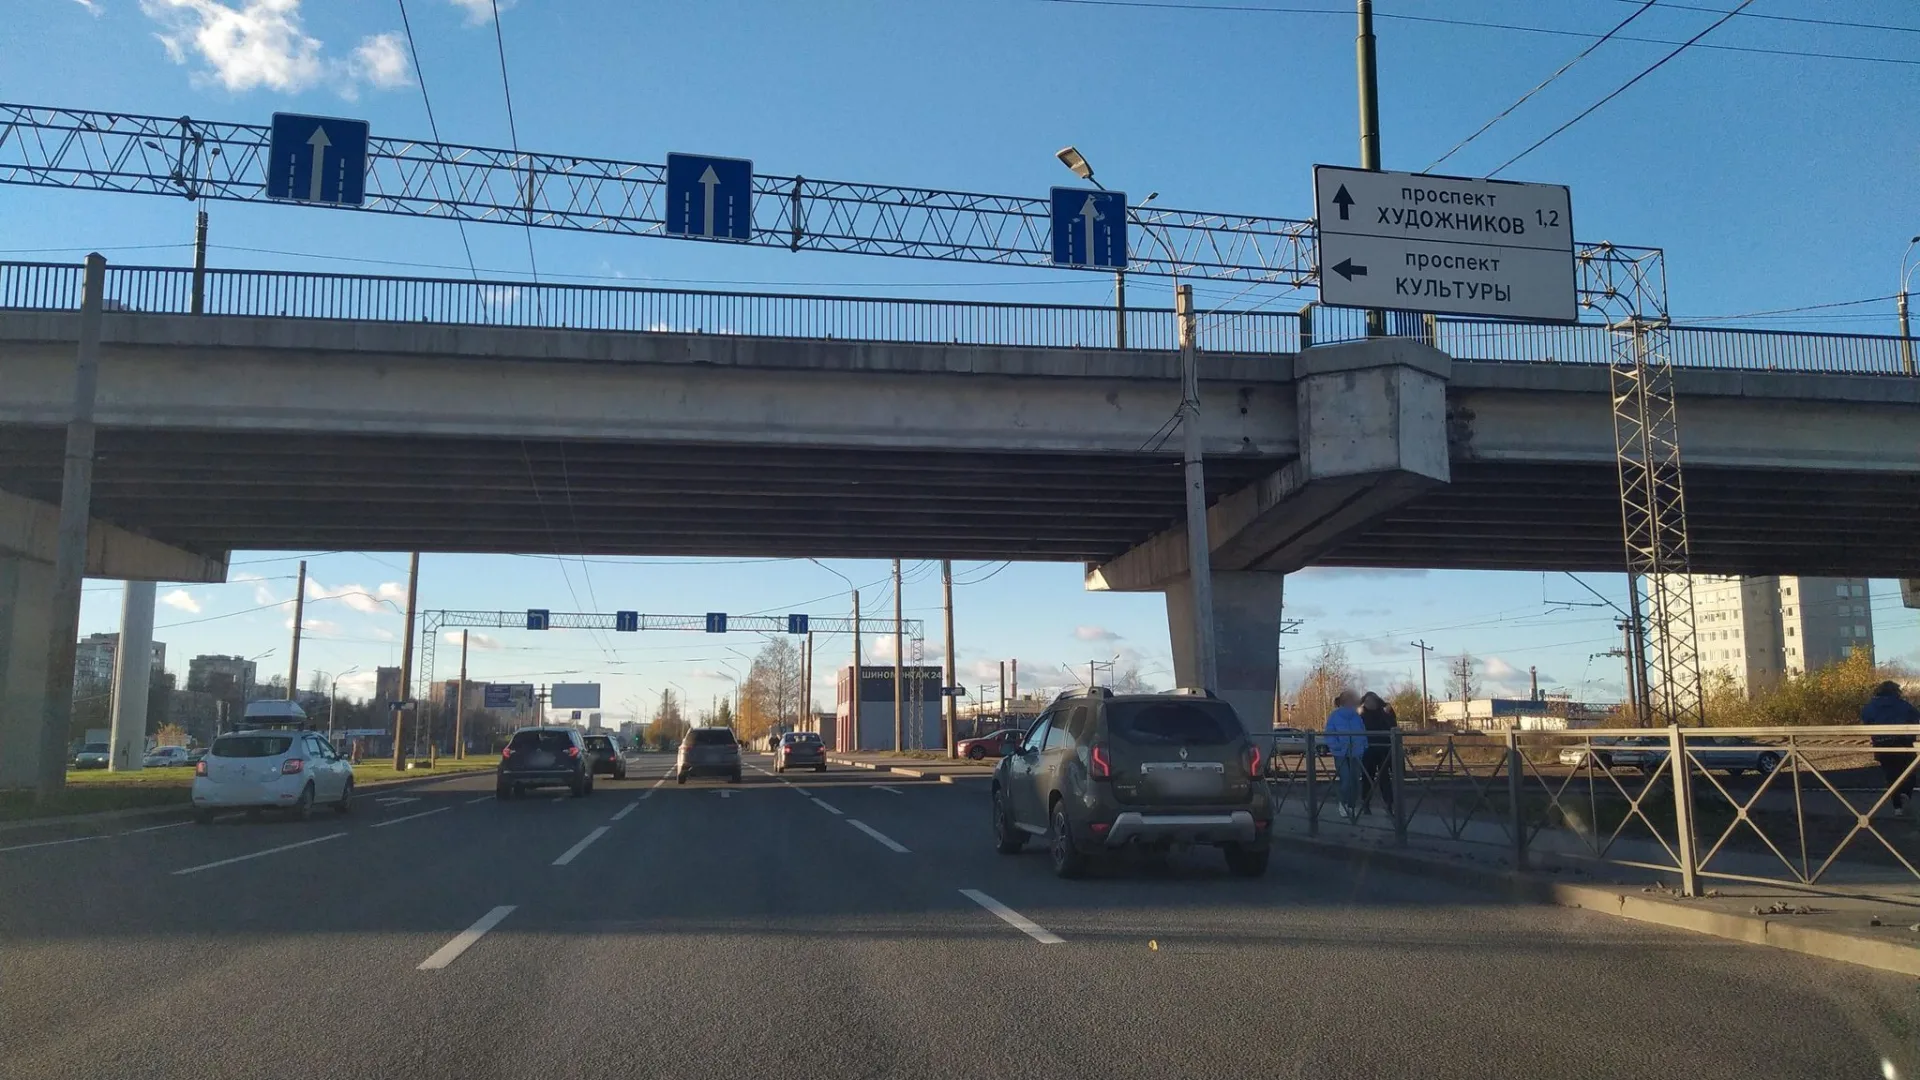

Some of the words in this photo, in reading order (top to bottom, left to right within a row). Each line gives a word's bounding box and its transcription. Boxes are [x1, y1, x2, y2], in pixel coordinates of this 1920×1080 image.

[1401, 187, 1496, 207] проспект
[1377, 206, 1525, 234] ХУДОЖНИКОВ
[1535, 209, 1559, 228] 1,2
[1406, 252, 1500, 271] проспект
[1396, 277, 1511, 302] КУЛЬТУРЫ
[862, 671, 930, 679] ШИНОМНТАЖ
